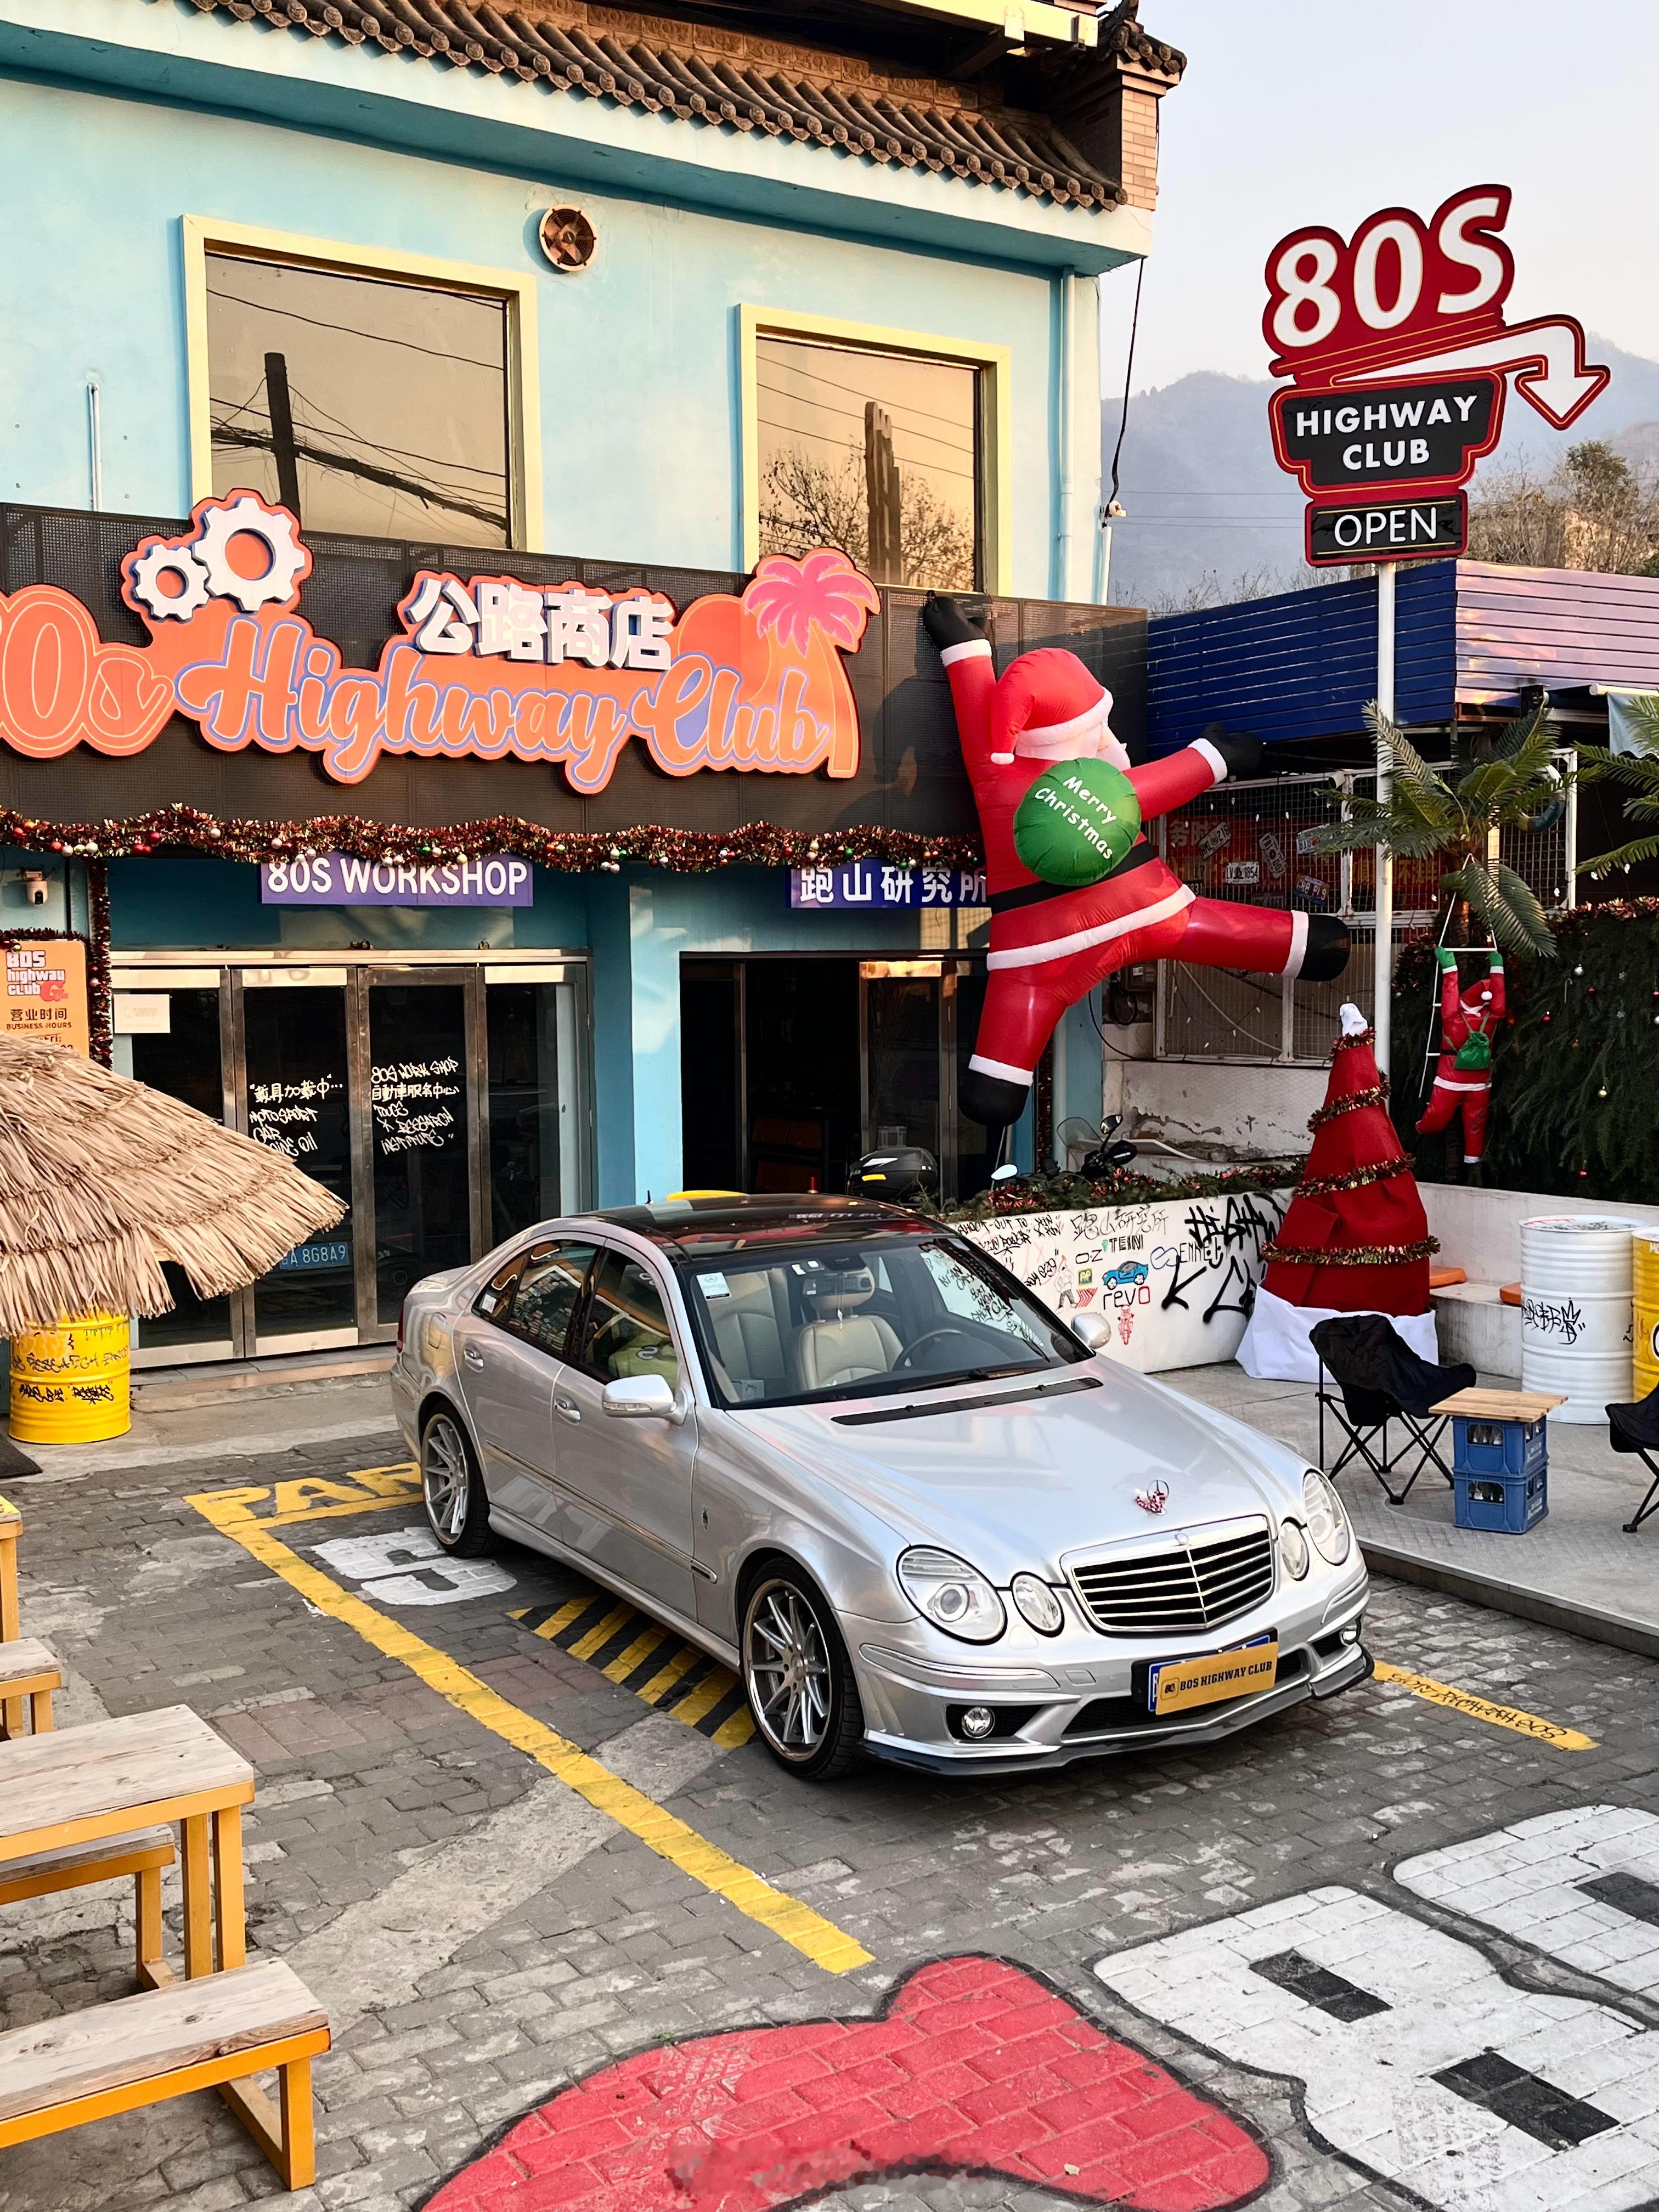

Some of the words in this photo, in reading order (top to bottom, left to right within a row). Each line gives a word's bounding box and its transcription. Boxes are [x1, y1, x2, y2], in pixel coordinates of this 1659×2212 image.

[1273, 197, 1503, 347] 80S
[1296, 395, 1477, 437] HIGHWAY
[1342, 439, 1430, 470] CLUB
[1334, 507, 1437, 546] OPEN
[408, 578, 674, 670] 公路商店
[176, 616, 627, 785] Highway
[631, 654, 830, 766] Club
[1063, 776, 1117, 824] Merry
[1035, 788, 1113, 859] Christmas
[268, 857, 332, 893] 80S
[340, 857, 527, 895] WORKSHOP
[800, 863, 987, 904] 跑山研究所
[6, 950, 46, 968] 80S
[10, 1008, 67, 1022] 营业时间
[302, 1244, 347, 1263] 8G8A9
[1109, 1234, 1143, 1254] TEIN
[1180, 1678, 1199, 1691] 80S
[1200, 1667, 1246, 1686] HIGHWAY
[1248, 1661, 1273, 1676] CLUB
